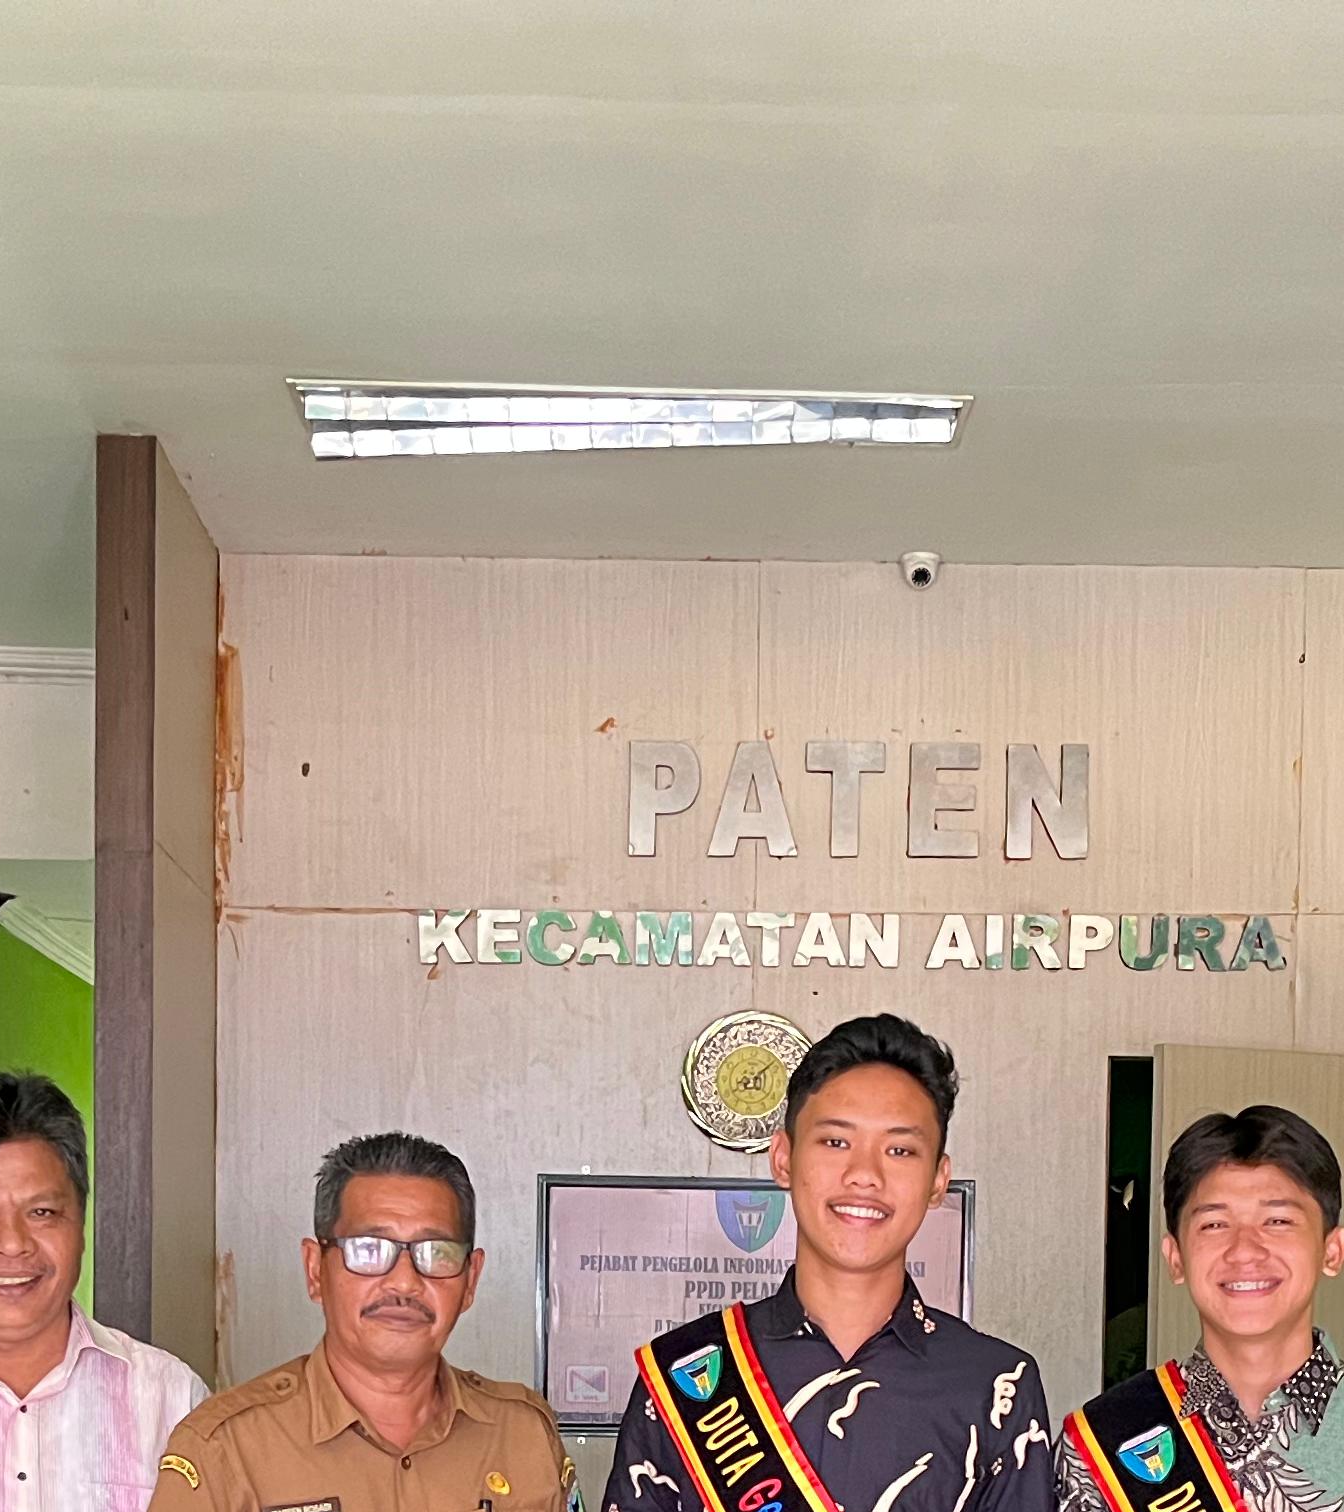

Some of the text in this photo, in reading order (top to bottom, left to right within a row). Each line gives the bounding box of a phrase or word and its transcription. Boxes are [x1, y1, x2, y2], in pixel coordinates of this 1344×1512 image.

[626, 740, 1090, 860] PATEN
[417, 908, 1288, 973] KECAMATAN AIRPURA
[580, 1254, 794, 1275] PEJABAT PENGELOLA INFORMAS
[684, 1280, 726, 1299] PPID
[696, 1396, 765, 1488] DUTA
